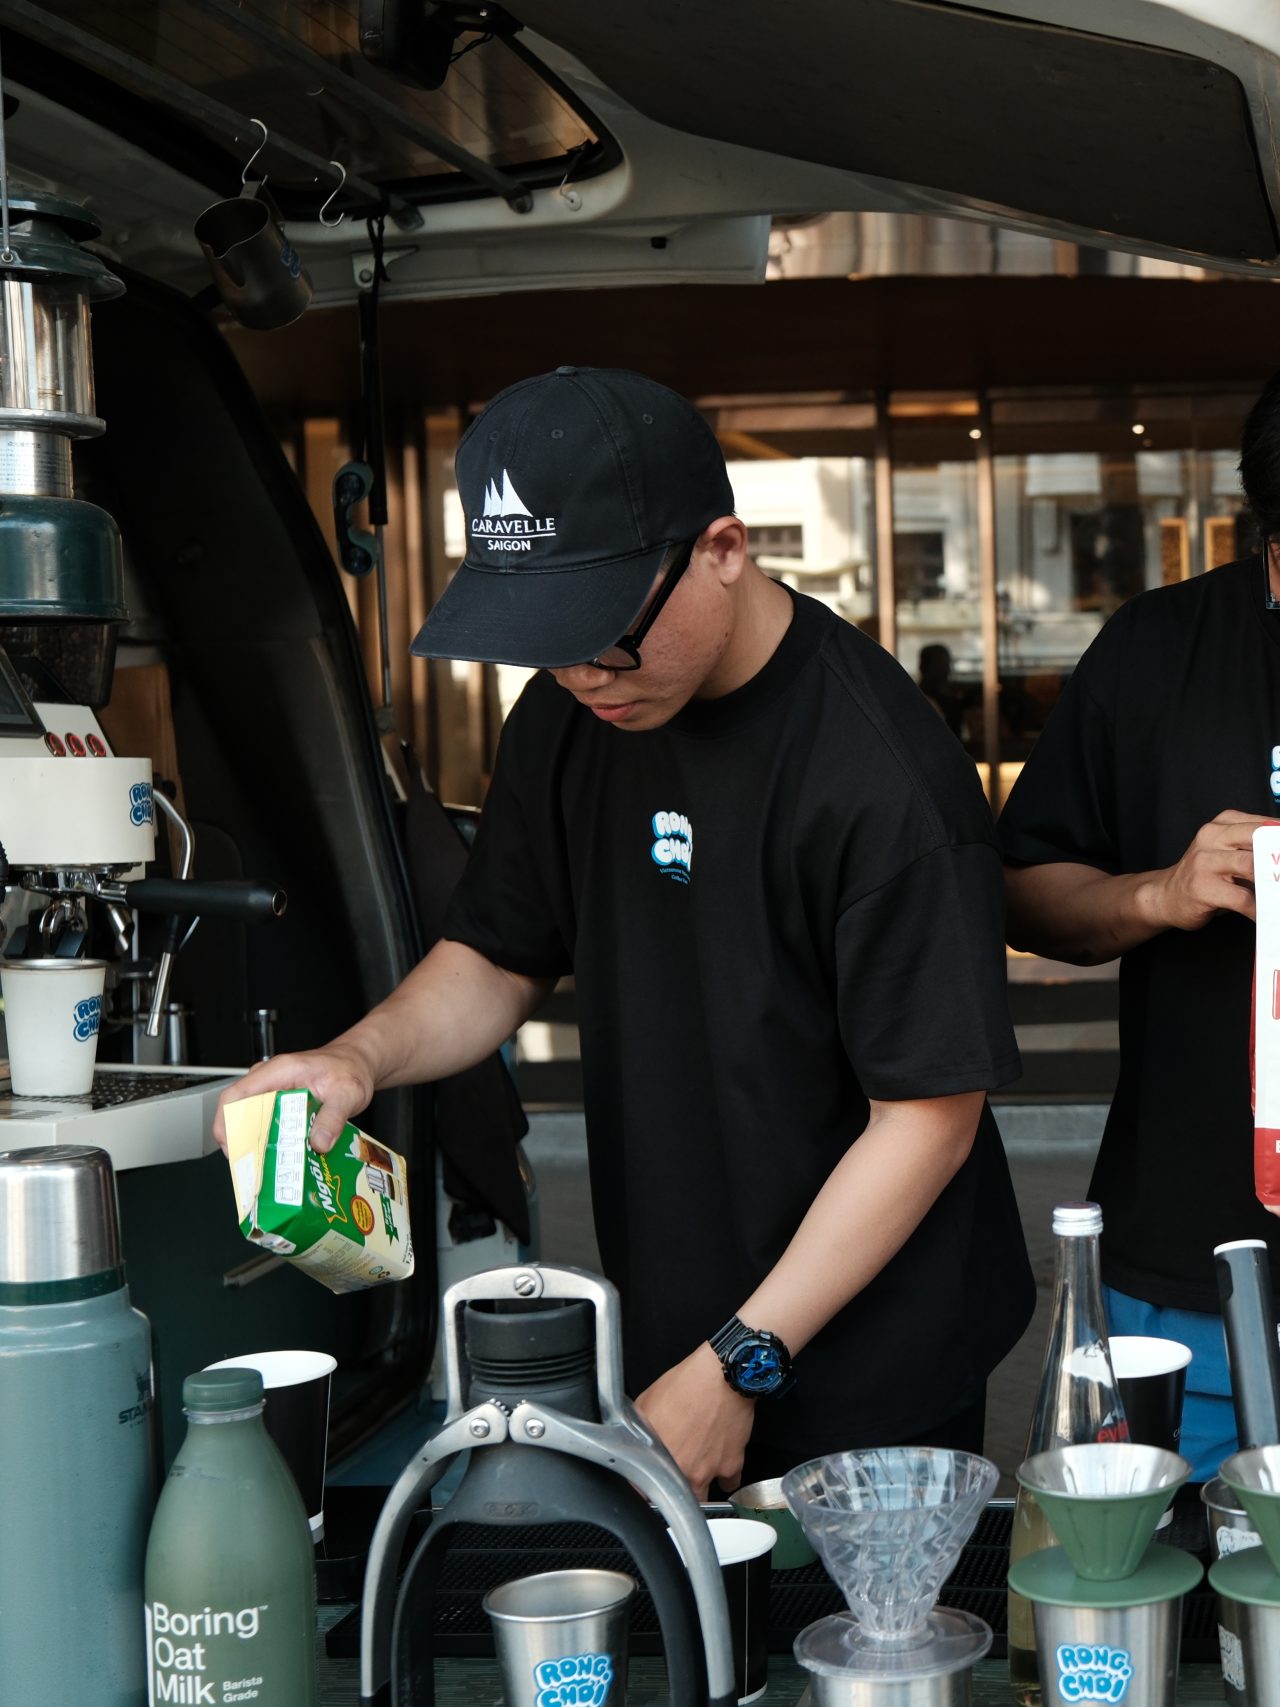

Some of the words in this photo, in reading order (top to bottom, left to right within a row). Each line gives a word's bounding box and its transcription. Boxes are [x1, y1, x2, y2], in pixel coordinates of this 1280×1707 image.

[471, 517, 556, 534] CARAVELLE
[487, 540, 531, 551] SAIGON
[153, 1601, 260, 1639] Boring
[154, 1637, 207, 1671] Oat
[1057, 1645, 1132, 1675] RONG
[156, 1669, 217, 1705] Milk
[222, 1677, 263, 1691] Barista
[536, 1655, 611, 1690] RONG
[222, 1690, 259, 1703] Grade
